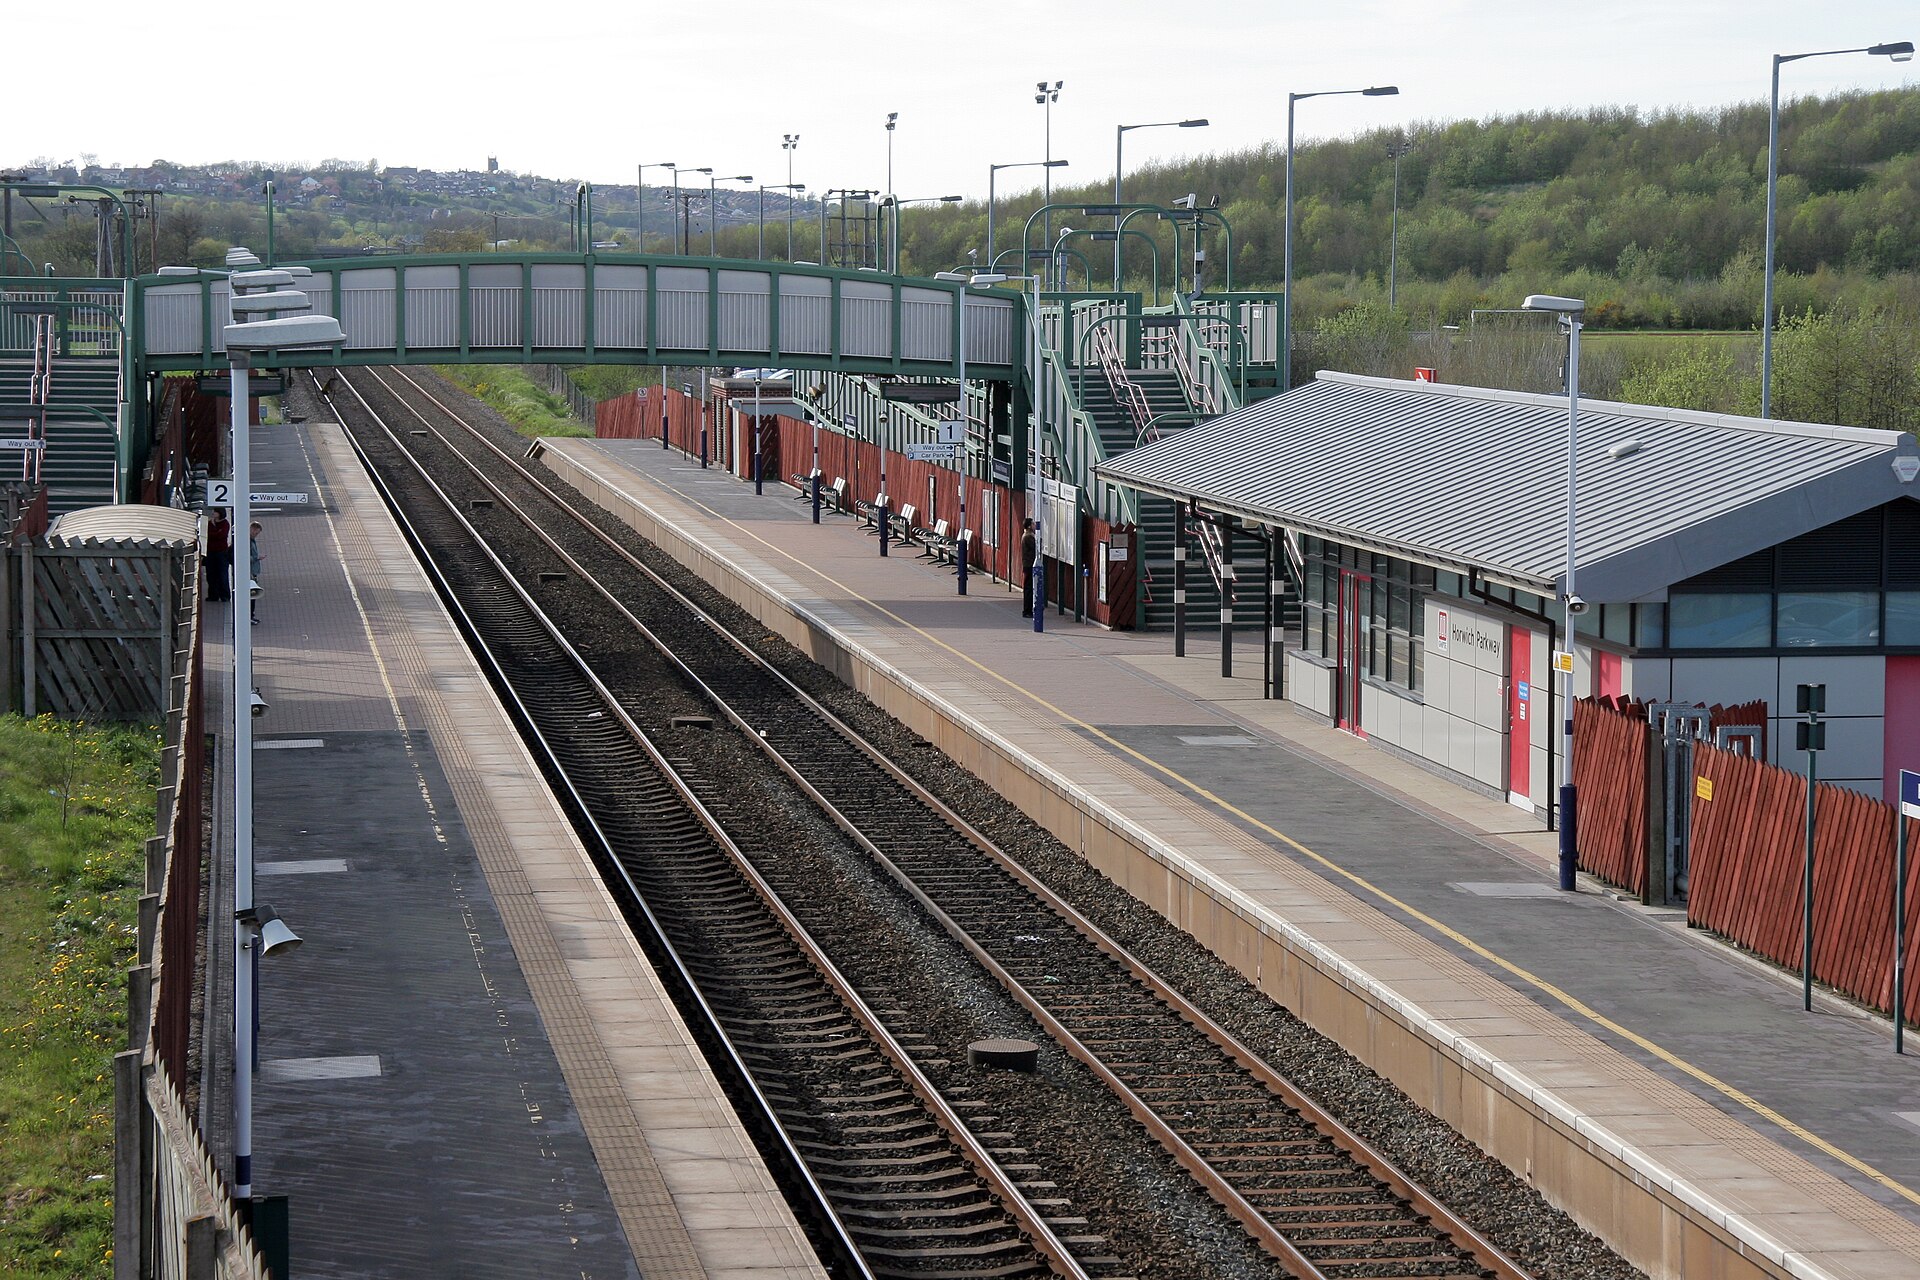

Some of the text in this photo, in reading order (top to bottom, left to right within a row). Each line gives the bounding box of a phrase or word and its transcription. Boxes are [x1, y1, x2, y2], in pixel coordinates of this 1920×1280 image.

[947, 425, 953, 439] 1
[214, 484, 228, 502] 2
[259, 494, 275, 502] Way
[1452, 623, 1501, 658] Horwich Parkway
